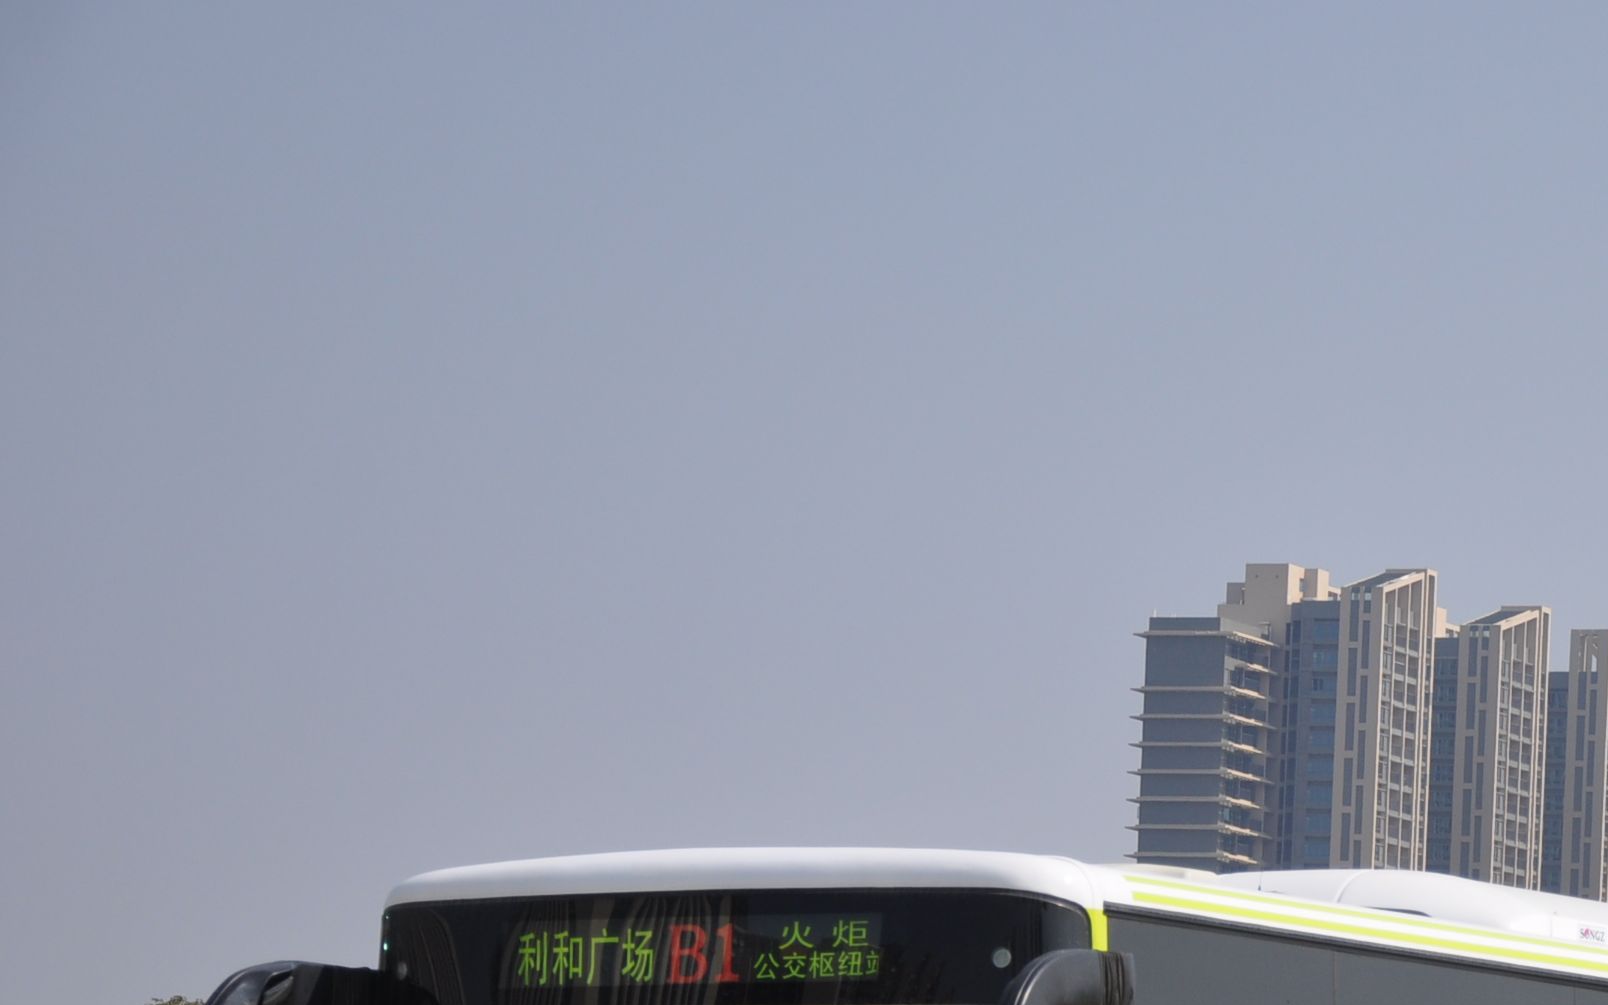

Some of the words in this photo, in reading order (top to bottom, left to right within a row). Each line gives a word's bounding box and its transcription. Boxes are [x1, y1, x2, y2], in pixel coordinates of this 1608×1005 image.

[518, 927, 654, 986] 利和广场
[667, 923, 740, 984] B1
